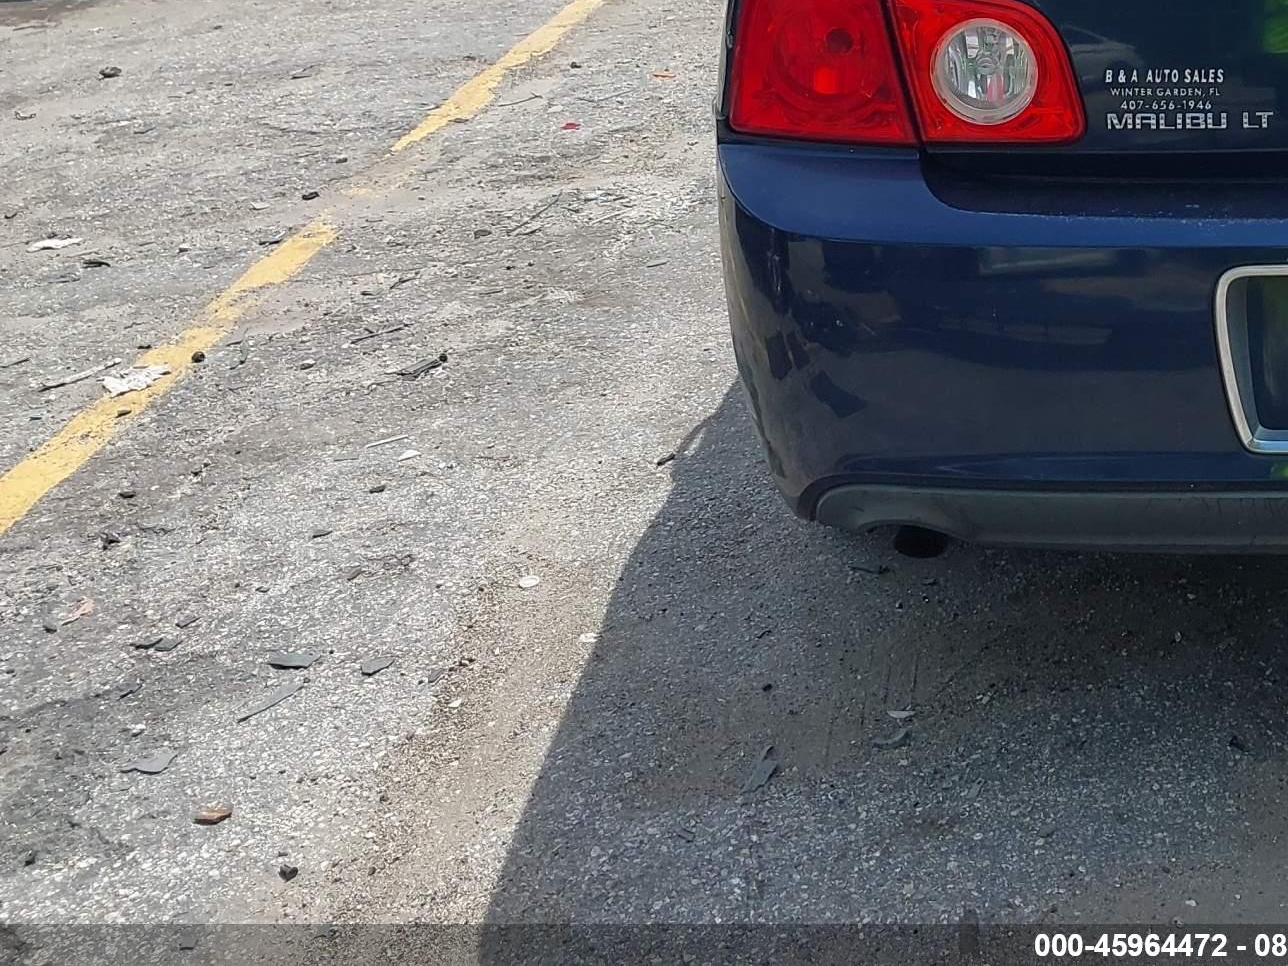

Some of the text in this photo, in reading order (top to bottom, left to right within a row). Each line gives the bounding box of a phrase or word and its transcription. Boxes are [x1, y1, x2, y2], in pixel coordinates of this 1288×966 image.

[1105, 68, 1224, 83] B & A AUTO SALES
[1110, 87, 1220, 98] WINTER GARDEN, FL
[1120, 99, 1212, 110] 407-656-1946
[1106, 111, 1274, 130] MALIBU LT
